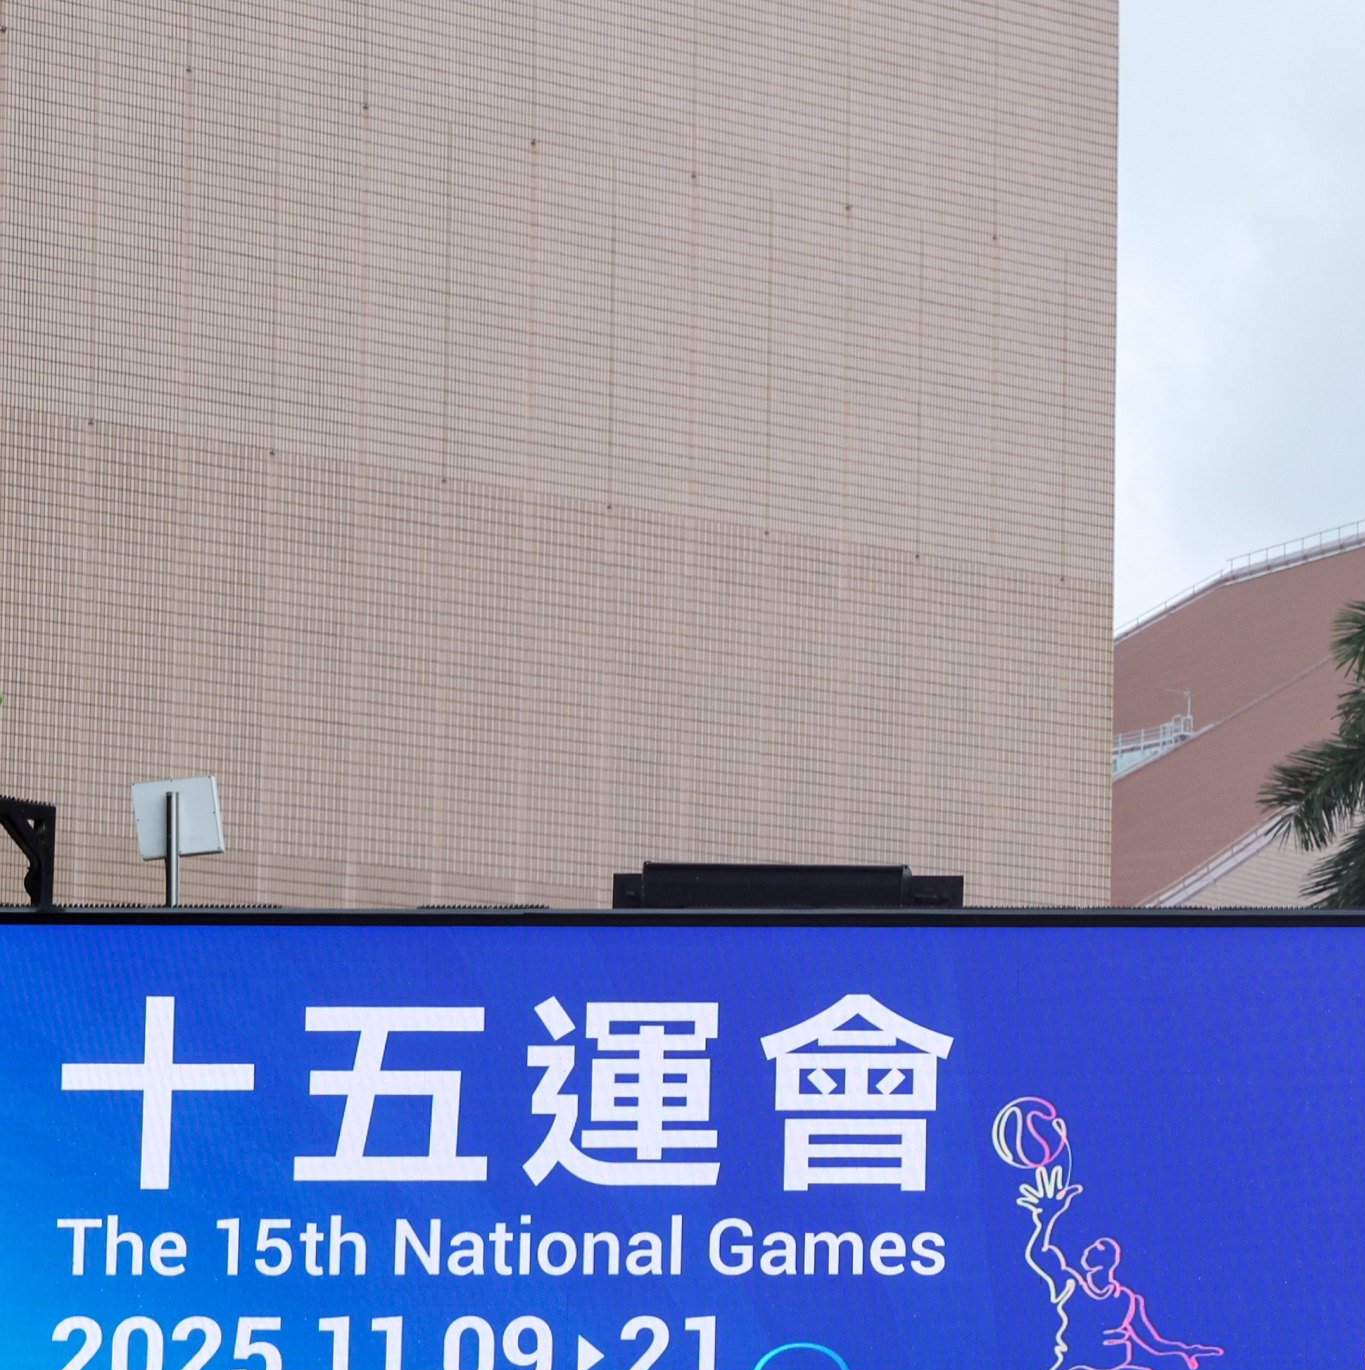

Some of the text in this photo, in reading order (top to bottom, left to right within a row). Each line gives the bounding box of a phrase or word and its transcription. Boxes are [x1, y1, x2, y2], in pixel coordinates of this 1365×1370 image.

[60, 993, 955, 1192] 十五運會
[57, 1214, 946, 1276] The 15th National Games
